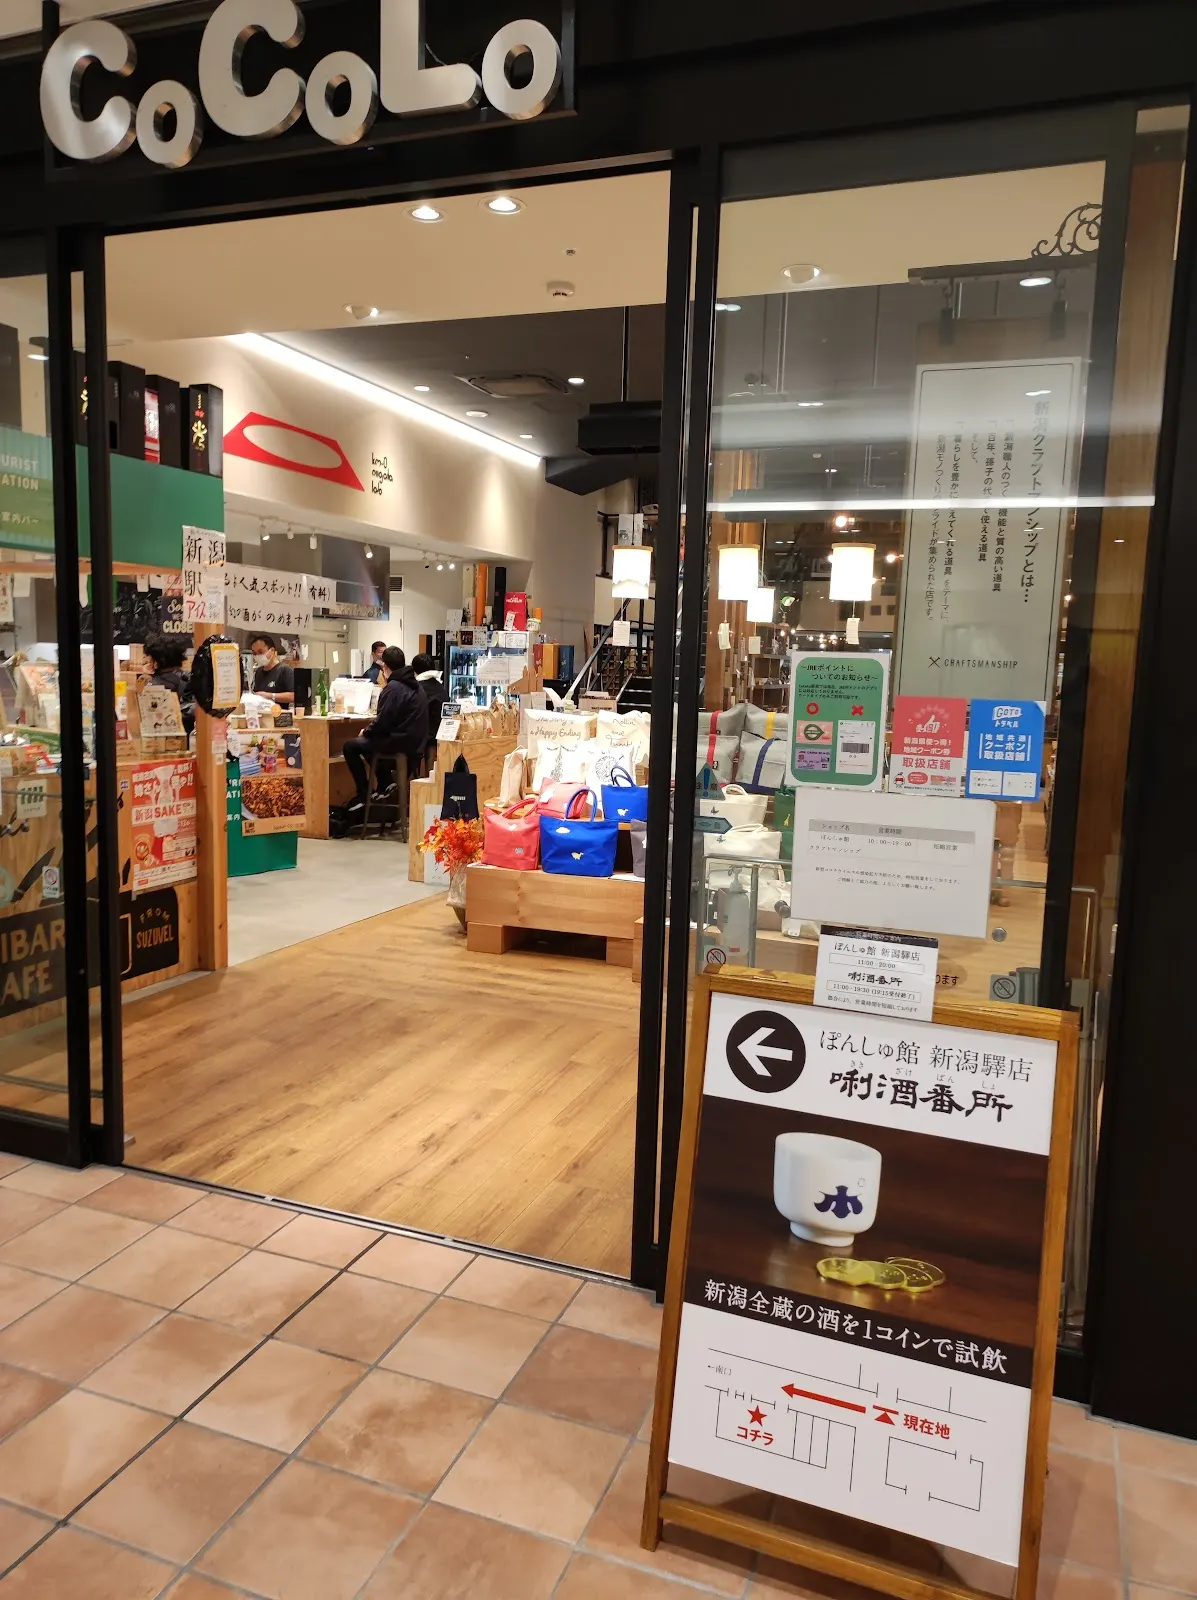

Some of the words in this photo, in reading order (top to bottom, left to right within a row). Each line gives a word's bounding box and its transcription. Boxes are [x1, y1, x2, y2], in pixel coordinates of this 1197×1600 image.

[40, 0, 562, 168] CoCoLo
[184, 535, 226, 568] 新潟
[184, 570, 203, 597] 駅
[185, 600, 207, 619] アイス
[944, 658, 1019, 670] CRAFTSMANSHIP
[534, 726, 558, 740] Happy
[559, 728, 582, 740] Ending
[994, 720, 1019, 729] トラベル
[984, 733, 1027, 742] 地域共通
[984, 741, 1026, 751] クーポン
[902, 757, 951, 771] 取扱店舗
[983, 751, 1027, 762] 取扱店舗
[878, 827, 903, 835] 営業時間
[139, 907, 172, 925] FROM
[1, 917, 66, 965] IBAR
[1, 960, 53, 1006] AFE
[819, 1030, 921, 1066] ぽんしゅ館
[929, 1044, 1033, 1083] 新潟驛店
[703, 1278, 1008, 1375] 新潟全蔵の酒を1コインで試飲
[714, 1364, 733, 1377] 南口
[736, 1424, 775, 1446] コチラ
[903, 1413, 951, 1440] 現在地
